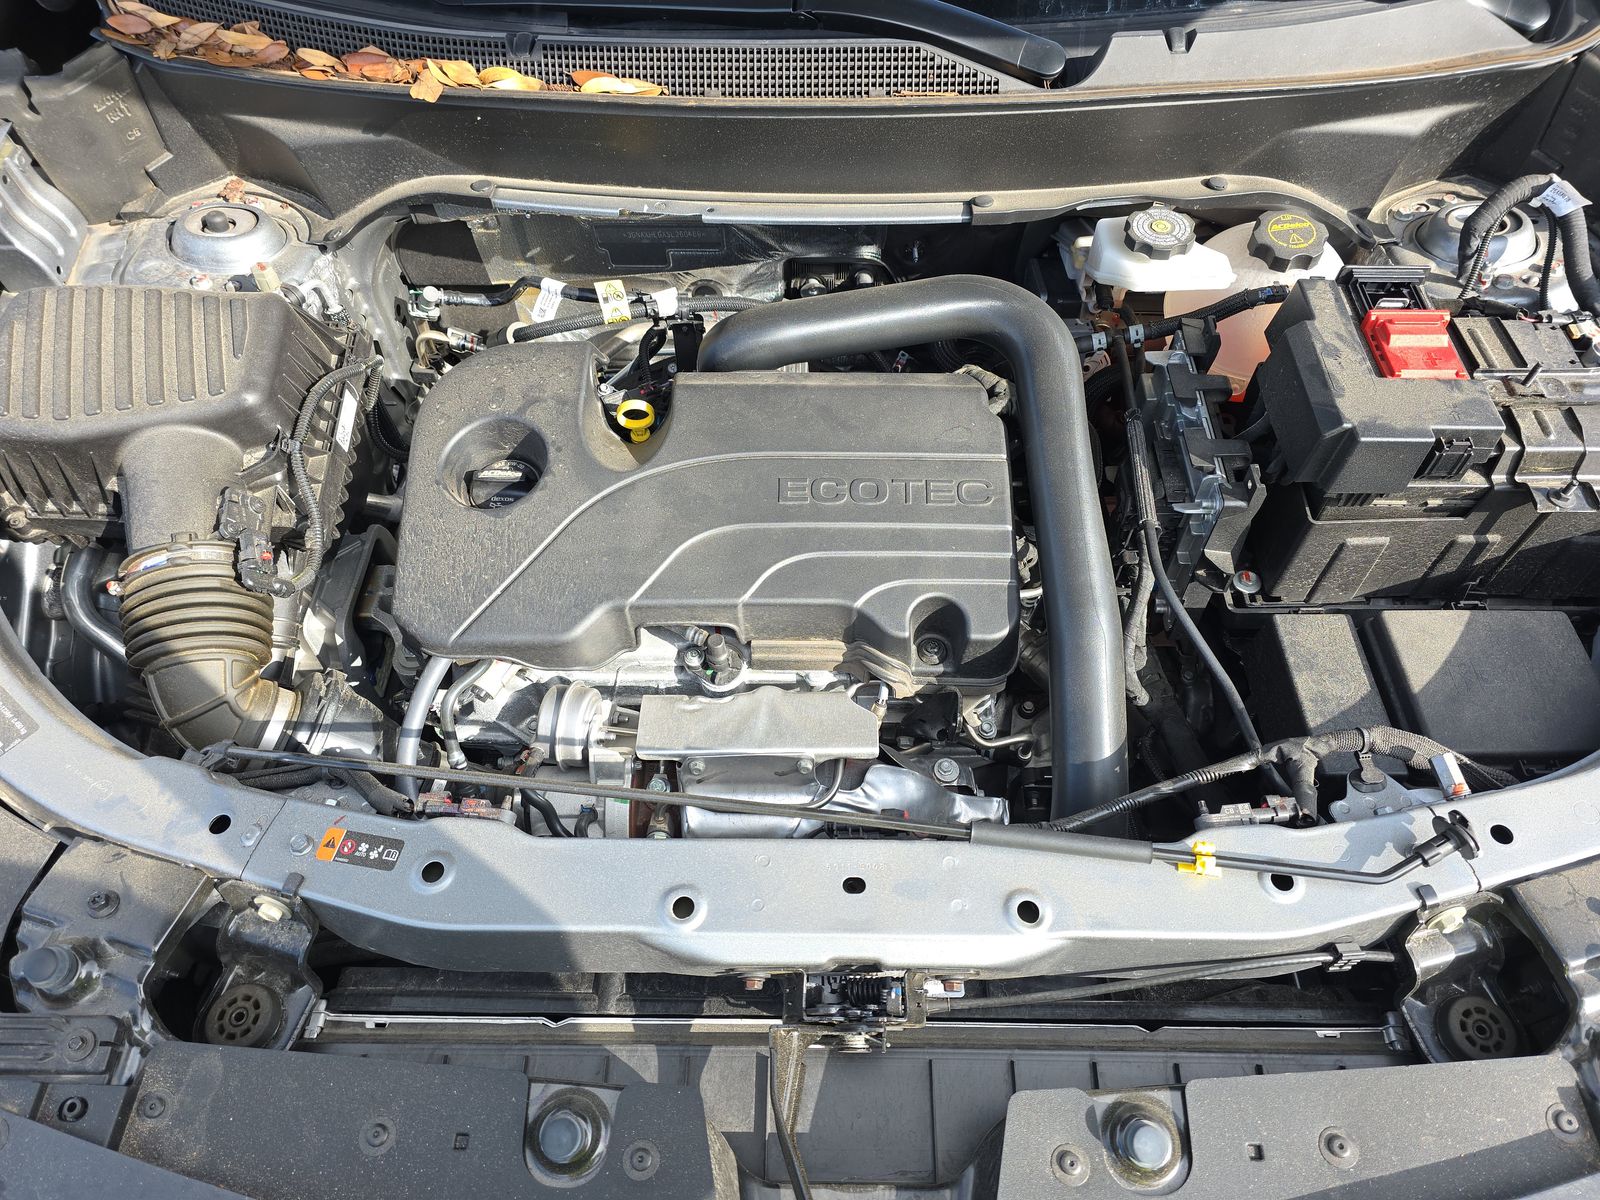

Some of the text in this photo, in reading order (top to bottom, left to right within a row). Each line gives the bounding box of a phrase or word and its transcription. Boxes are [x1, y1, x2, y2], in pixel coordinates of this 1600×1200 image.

[1270, 222, 1310, 232] ACDelco
[478, 469, 523, 478] ACDelco
[777, 477, 996, 507] ECOTEC
